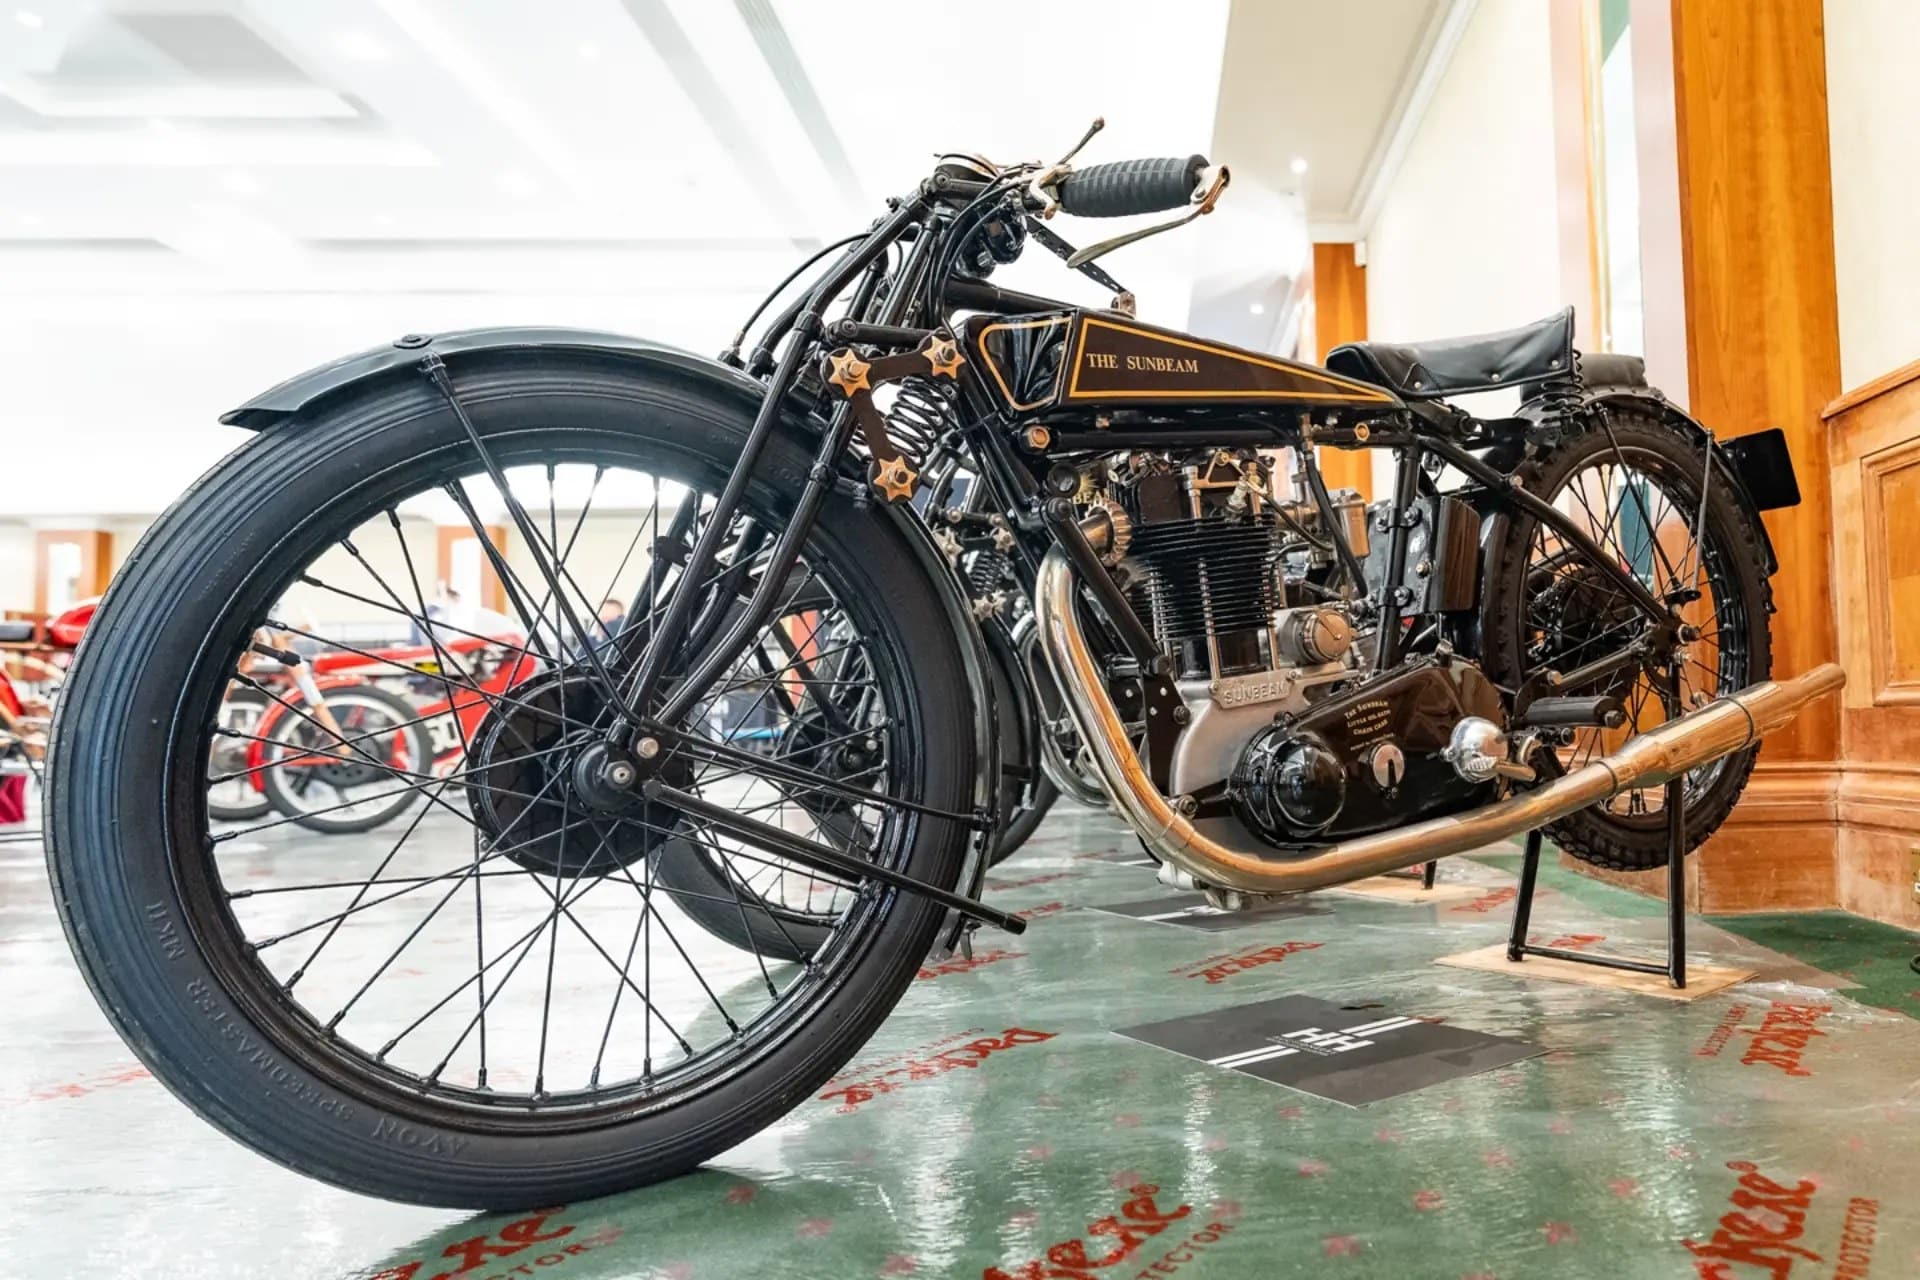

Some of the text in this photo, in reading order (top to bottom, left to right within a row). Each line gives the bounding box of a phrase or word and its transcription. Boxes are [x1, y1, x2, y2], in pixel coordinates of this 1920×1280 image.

[1086, 353, 1199, 373] THE SUNBEAM
[1223, 681, 1290, 704] SUNBEAM
[371, 1117, 470, 1157] AVON
